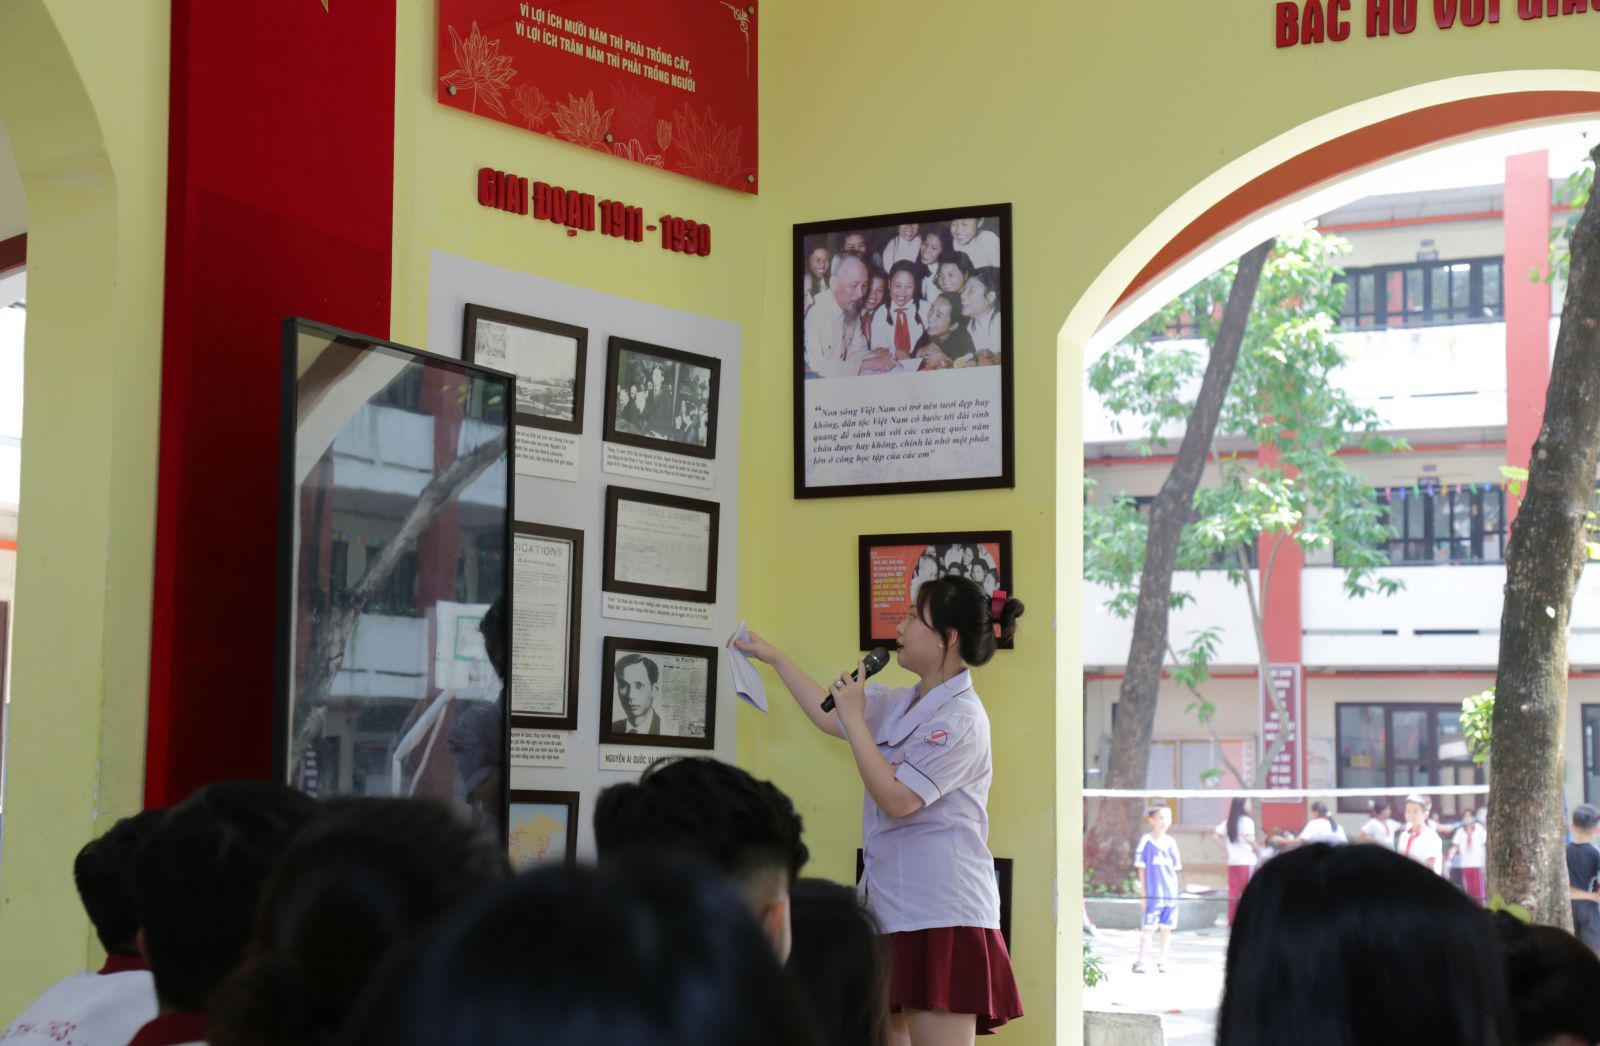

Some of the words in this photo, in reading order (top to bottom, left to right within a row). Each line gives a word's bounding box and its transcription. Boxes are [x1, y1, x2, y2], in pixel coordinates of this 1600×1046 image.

[520, 2, 529, 18] VÌ
[531, 7, 545, 24] LỢI
[547, 10, 562, 29] ÍCH
[564, 18, 587, 38] MƯỜI
[589, 27, 608, 45] NĂM
[609, 34, 623, 50] THÌ
[625, 40, 644, 57] PHẢI
[674, 55, 692, 75] CÂY,
[515, 20, 525, 37] VÌ
[526, 26, 540, 43] LỢI
[542, 28, 558, 48] ÍCH
[560, 36, 584, 56] TRĂM
[586, 45, 605, 63] NĂM
[606, 52, 620, 69] THÌ
[622, 58, 641, 75] PHẢI
[671, 74, 696, 93] NGƯỜI
[477, 167, 529, 216] GIAI
[532, 181, 595, 237] ĐOẠN
[598, 199, 643, 242] 1911
[659, 214, 711, 257] 1930
[860, 406, 876, 416] Việt
[877, 405, 896, 413] Nam
[974, 398, 989, 408] hay
[873, 417, 888, 426] Việt
[890, 416, 908, 424] Nam
[813, 434, 838, 443] quang
[874, 429, 887, 437] vai
[855, 442, 869, 452] hay
[514, 543, 562, 557] DICATIONS
